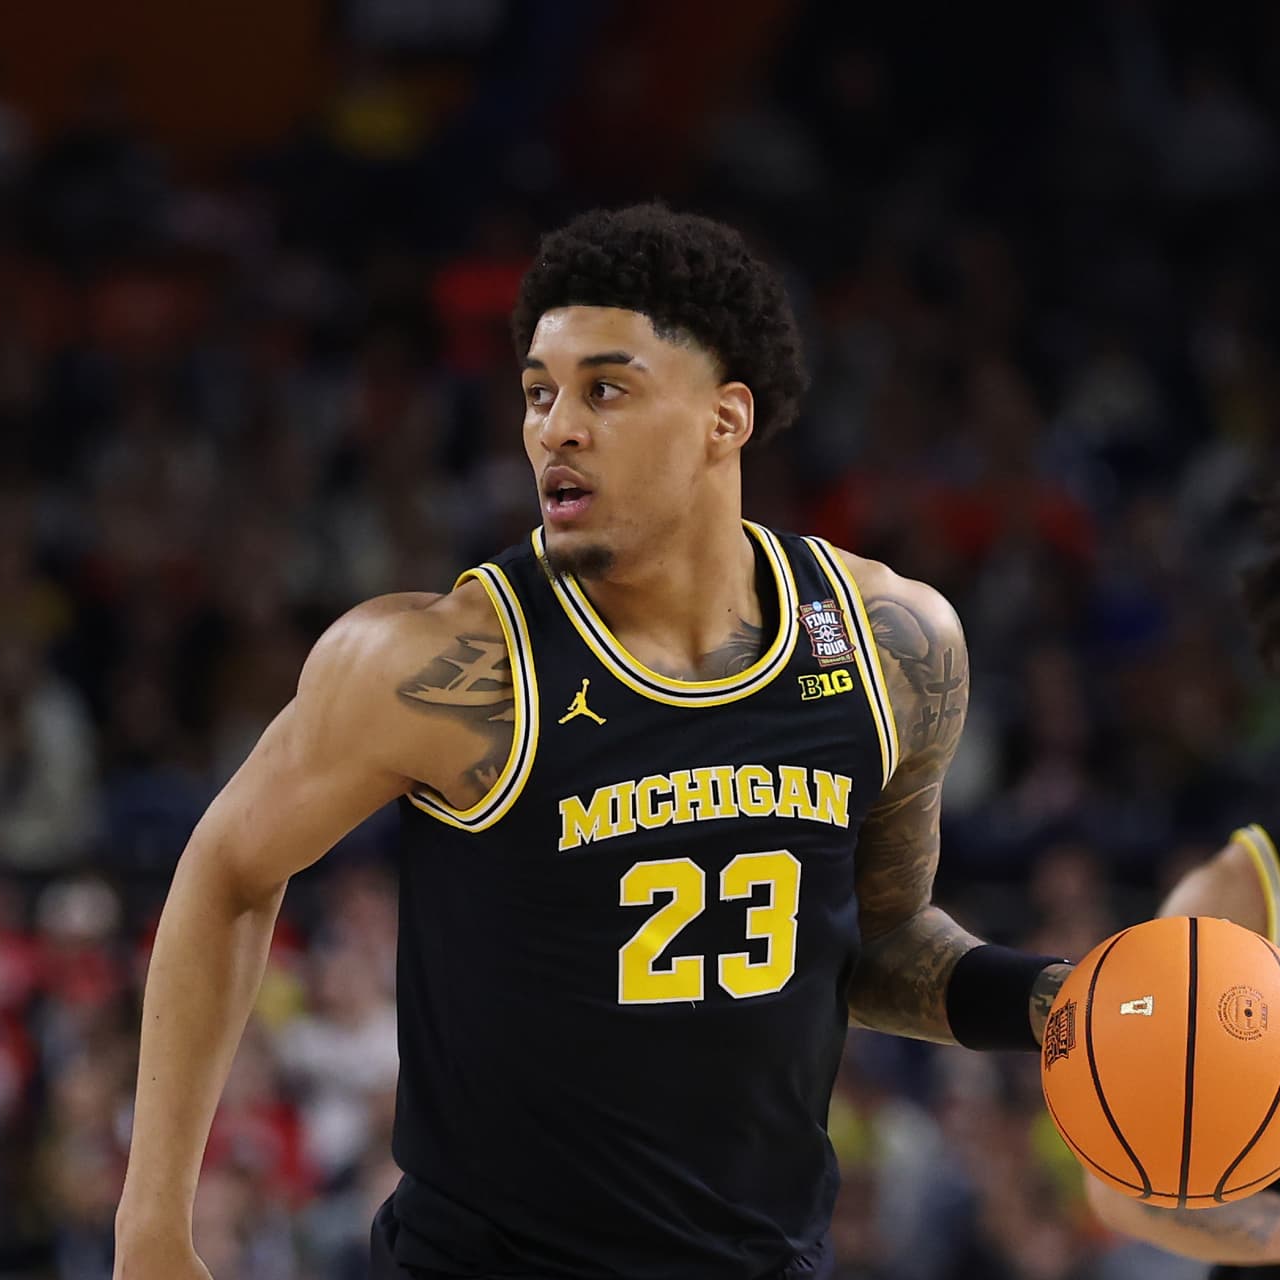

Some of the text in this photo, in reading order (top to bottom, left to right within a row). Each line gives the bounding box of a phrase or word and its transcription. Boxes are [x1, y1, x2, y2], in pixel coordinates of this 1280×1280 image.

[805, 612, 838, 629] FINAL
[816, 639, 848, 656] FOUR
[559, 765, 852, 851] MICHIGAN
[619, 849, 802, 1004] 23
